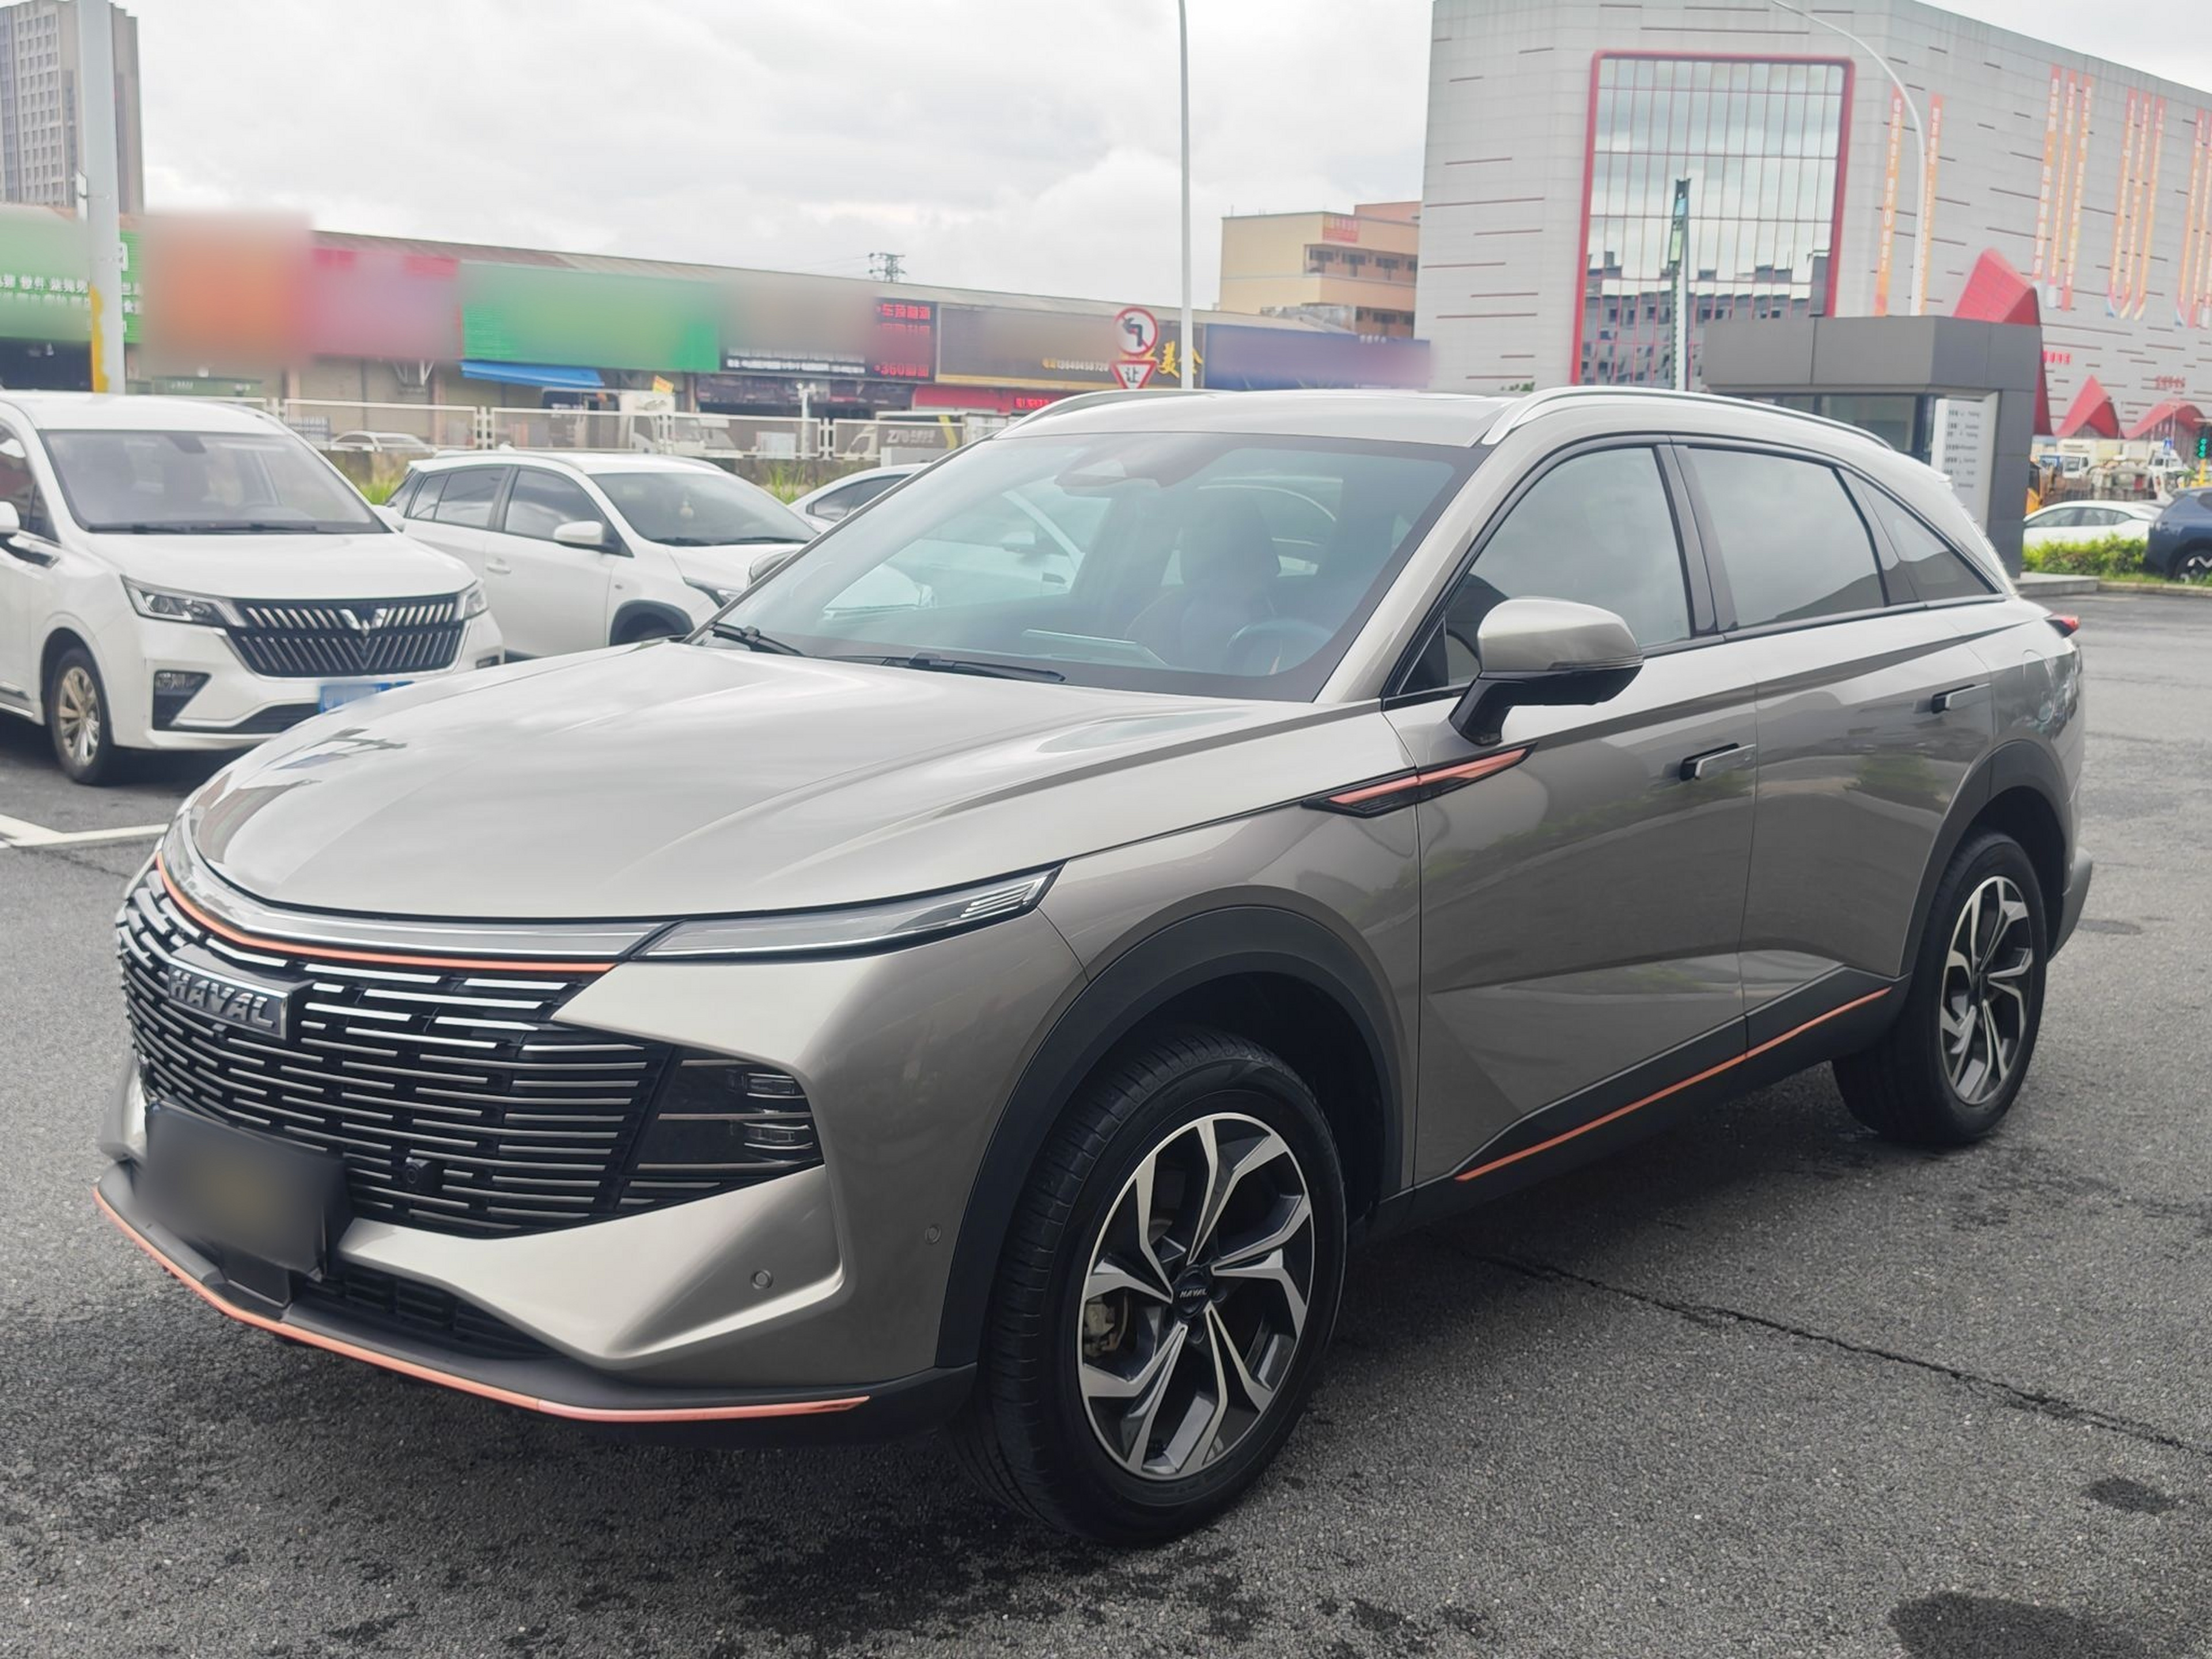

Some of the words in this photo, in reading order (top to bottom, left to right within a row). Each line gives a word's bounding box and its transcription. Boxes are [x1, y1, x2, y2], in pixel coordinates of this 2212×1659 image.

[1124, 366, 1139, 384] 让
[171, 969, 276, 1028] HAVAL
[1180, 1288, 1207, 1298] HAVAL
